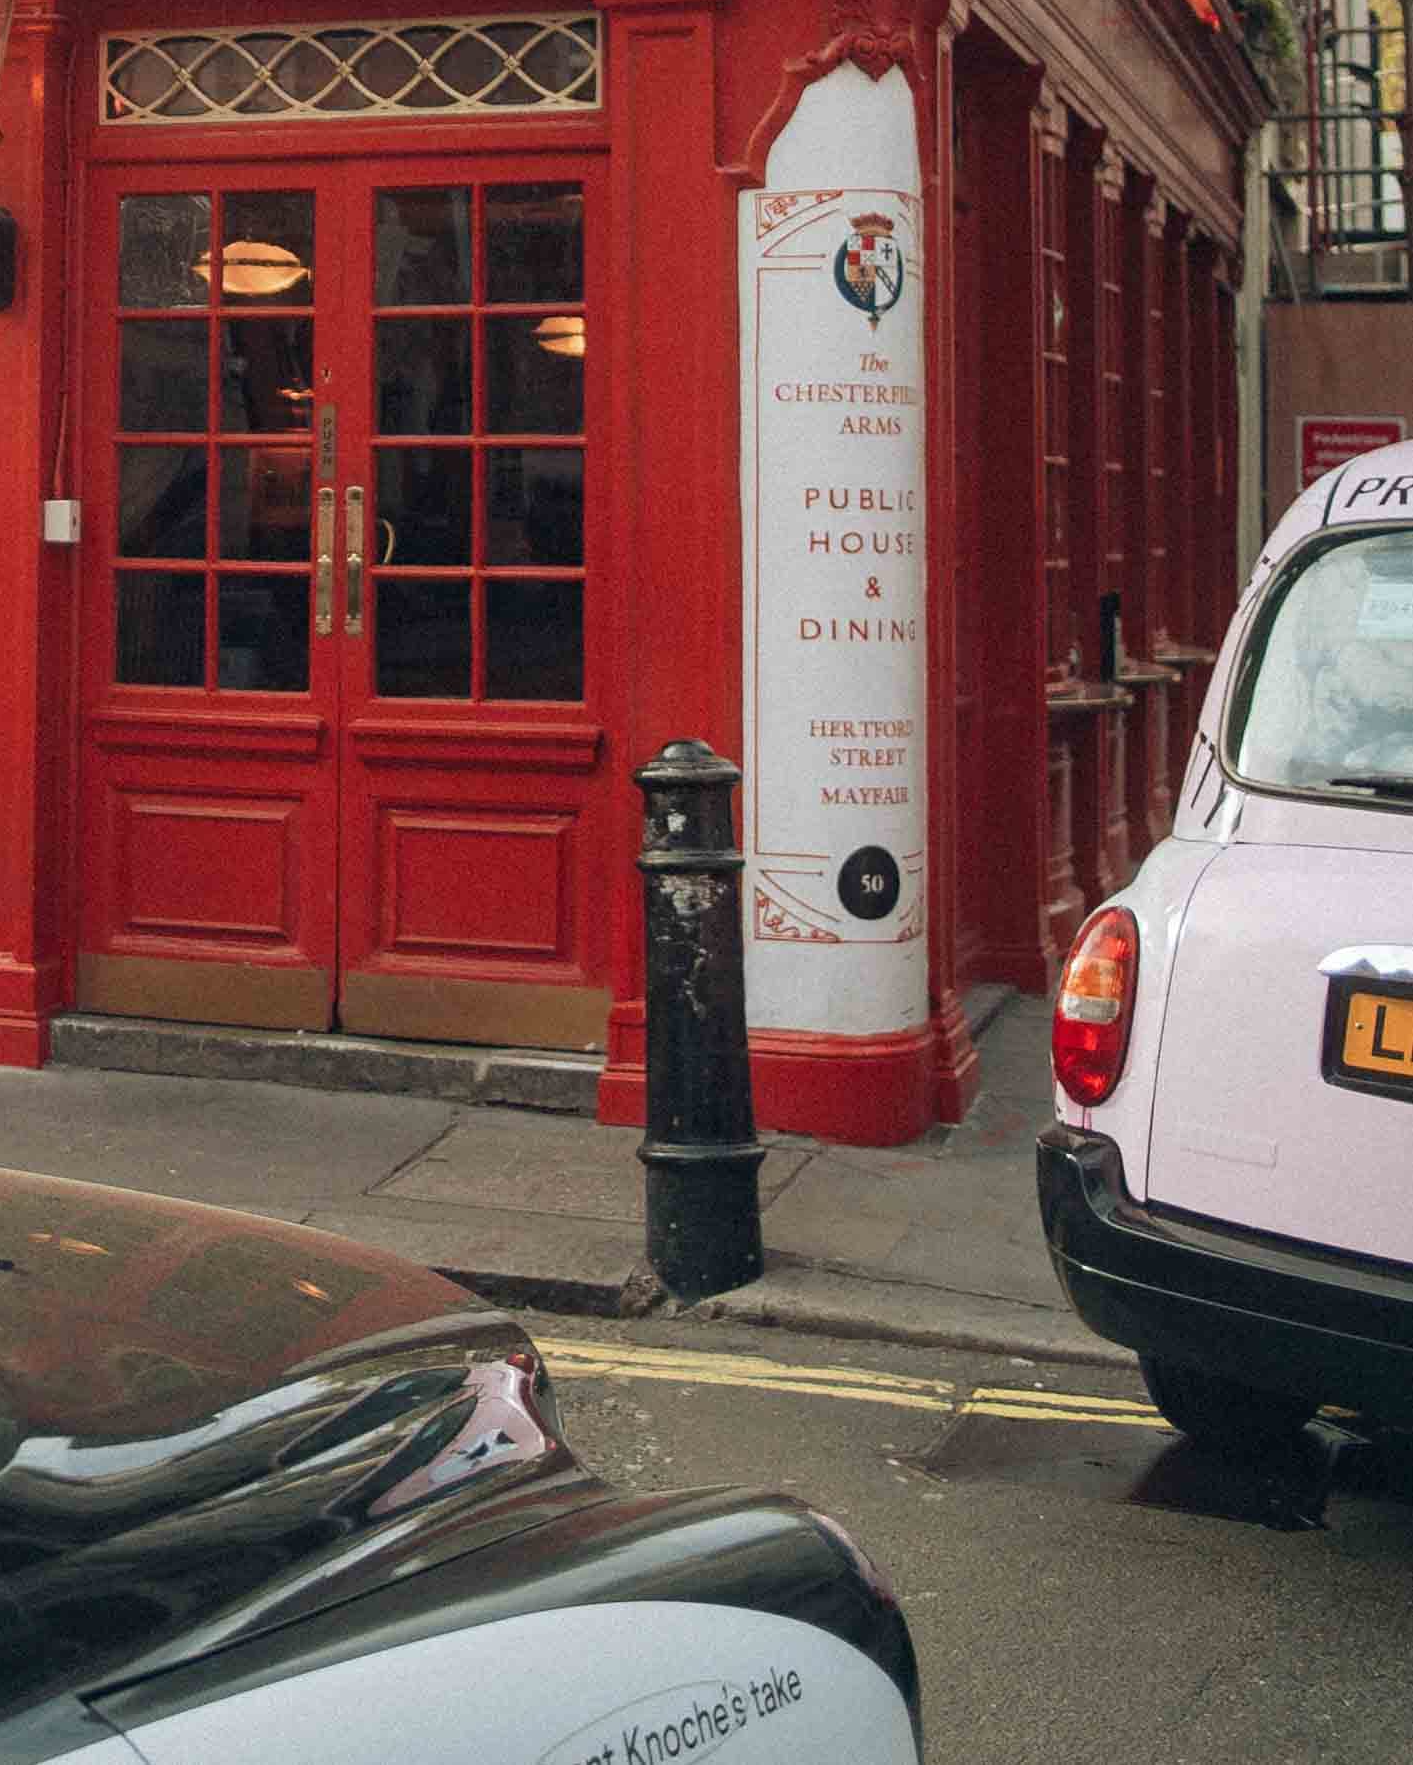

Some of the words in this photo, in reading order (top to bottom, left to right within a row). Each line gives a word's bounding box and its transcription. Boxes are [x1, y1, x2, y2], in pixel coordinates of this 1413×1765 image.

[859, 352, 890, 373] The
[839, 416, 902, 436] ARMS
[804, 487, 917, 512] PUBLIC
[808, 531, 916, 555] HOUSE
[864, 575, 883, 600] &
[799, 617, 917, 642] DINING
[829, 747, 908, 767] STREET
[860, 873, 885, 894] 50
[622, 1685, 748, 1765] Knoche's
[749, 1665, 804, 1719] take
